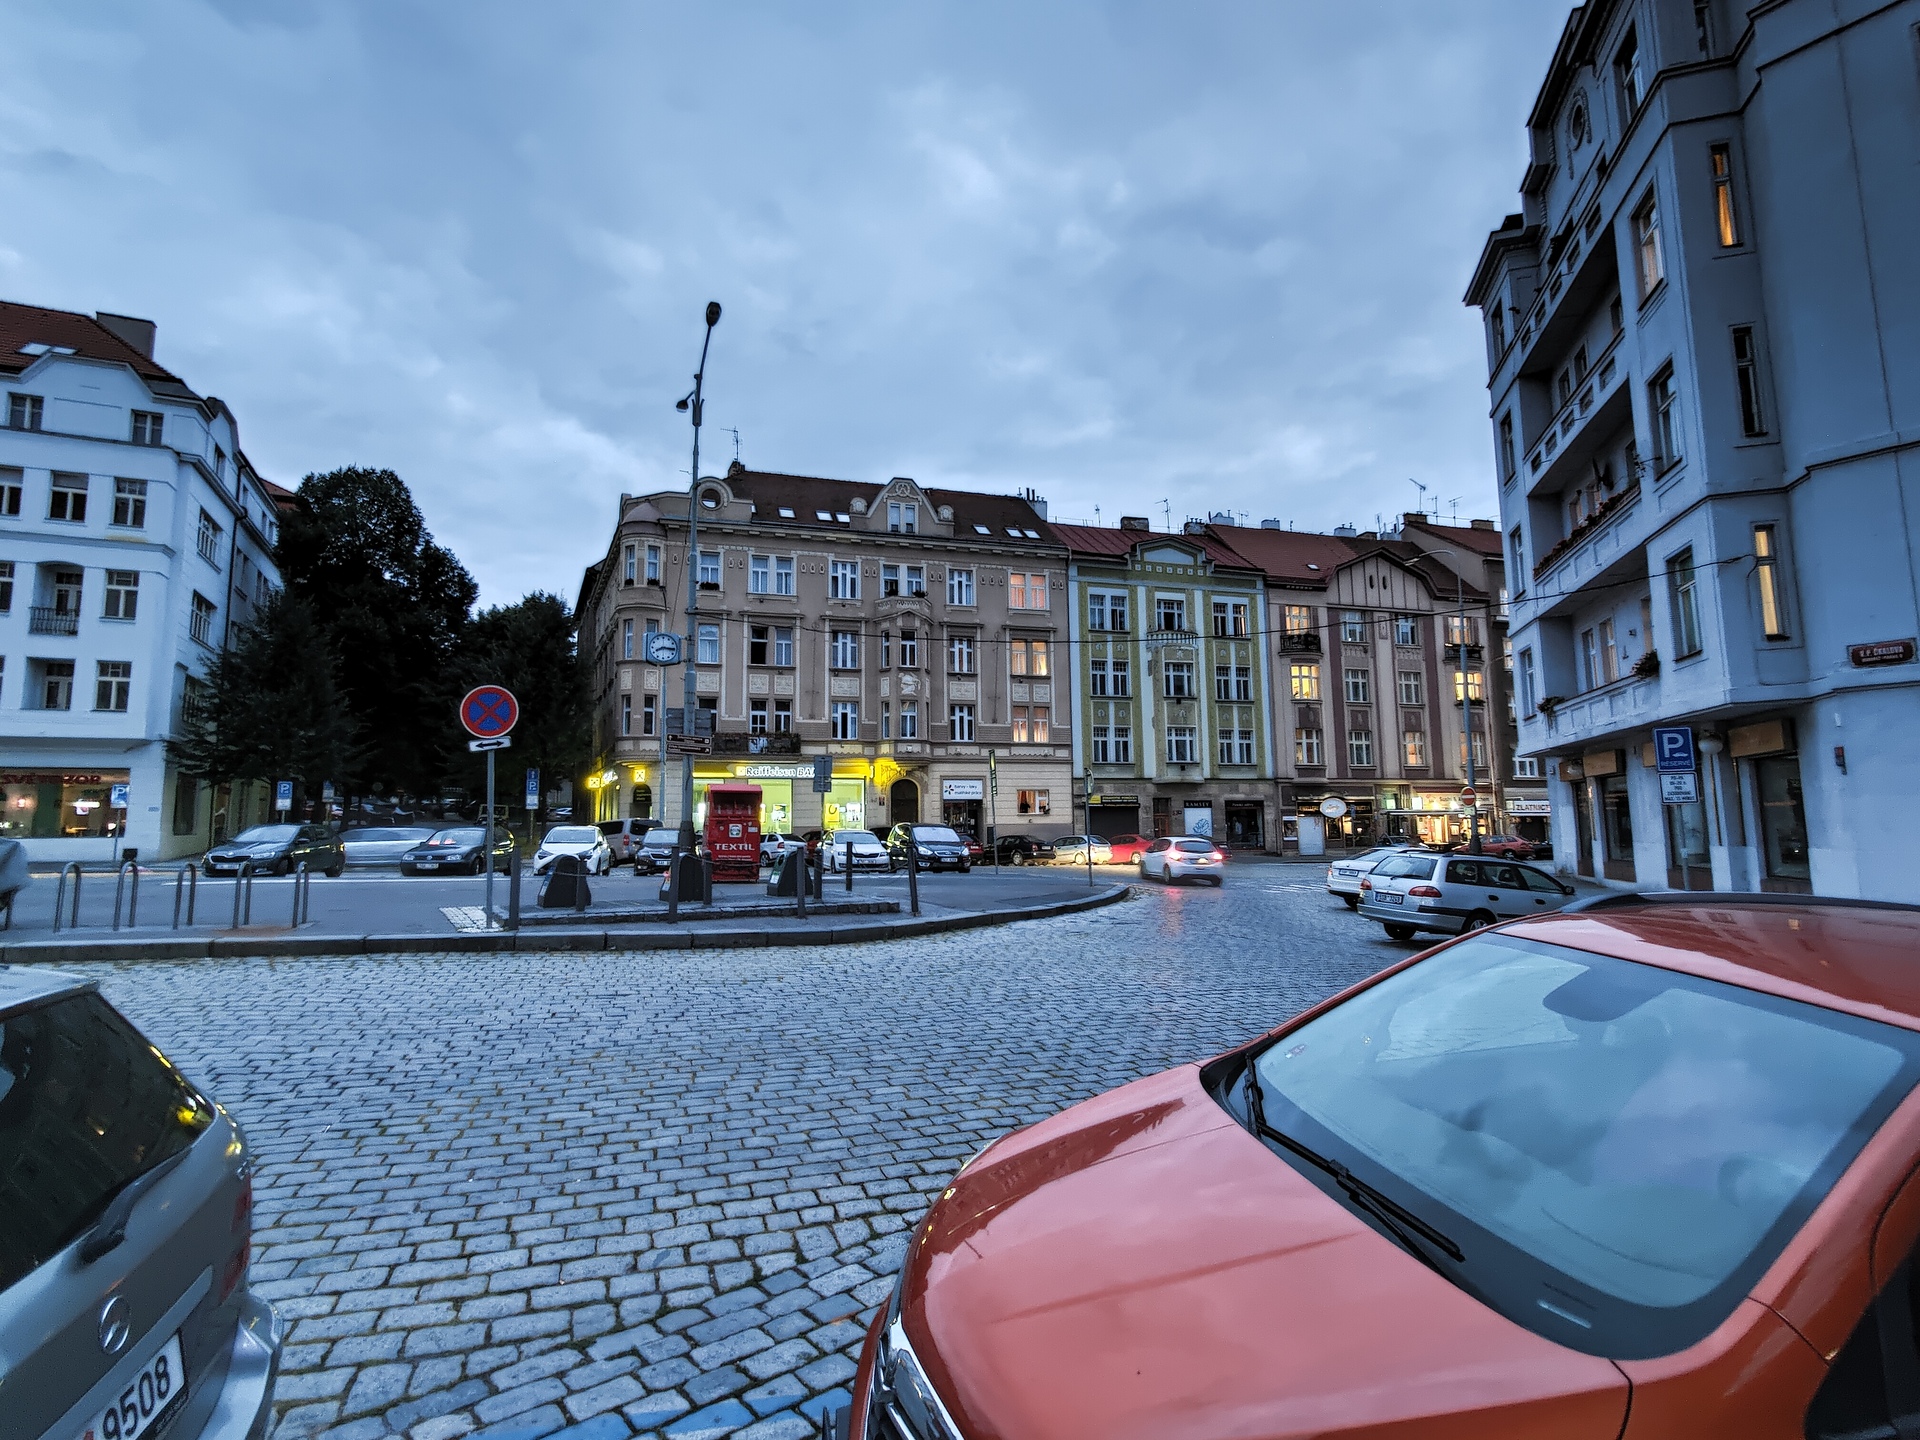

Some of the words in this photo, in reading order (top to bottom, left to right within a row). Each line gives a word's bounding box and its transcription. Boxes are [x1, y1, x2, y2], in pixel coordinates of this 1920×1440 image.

[1662, 733, 1684, 758] P
[746, 765, 796, 777] Raiffeisen
[714, 843, 755, 851] TEXTIL
[103, 1355, 170, 1440] 9508
